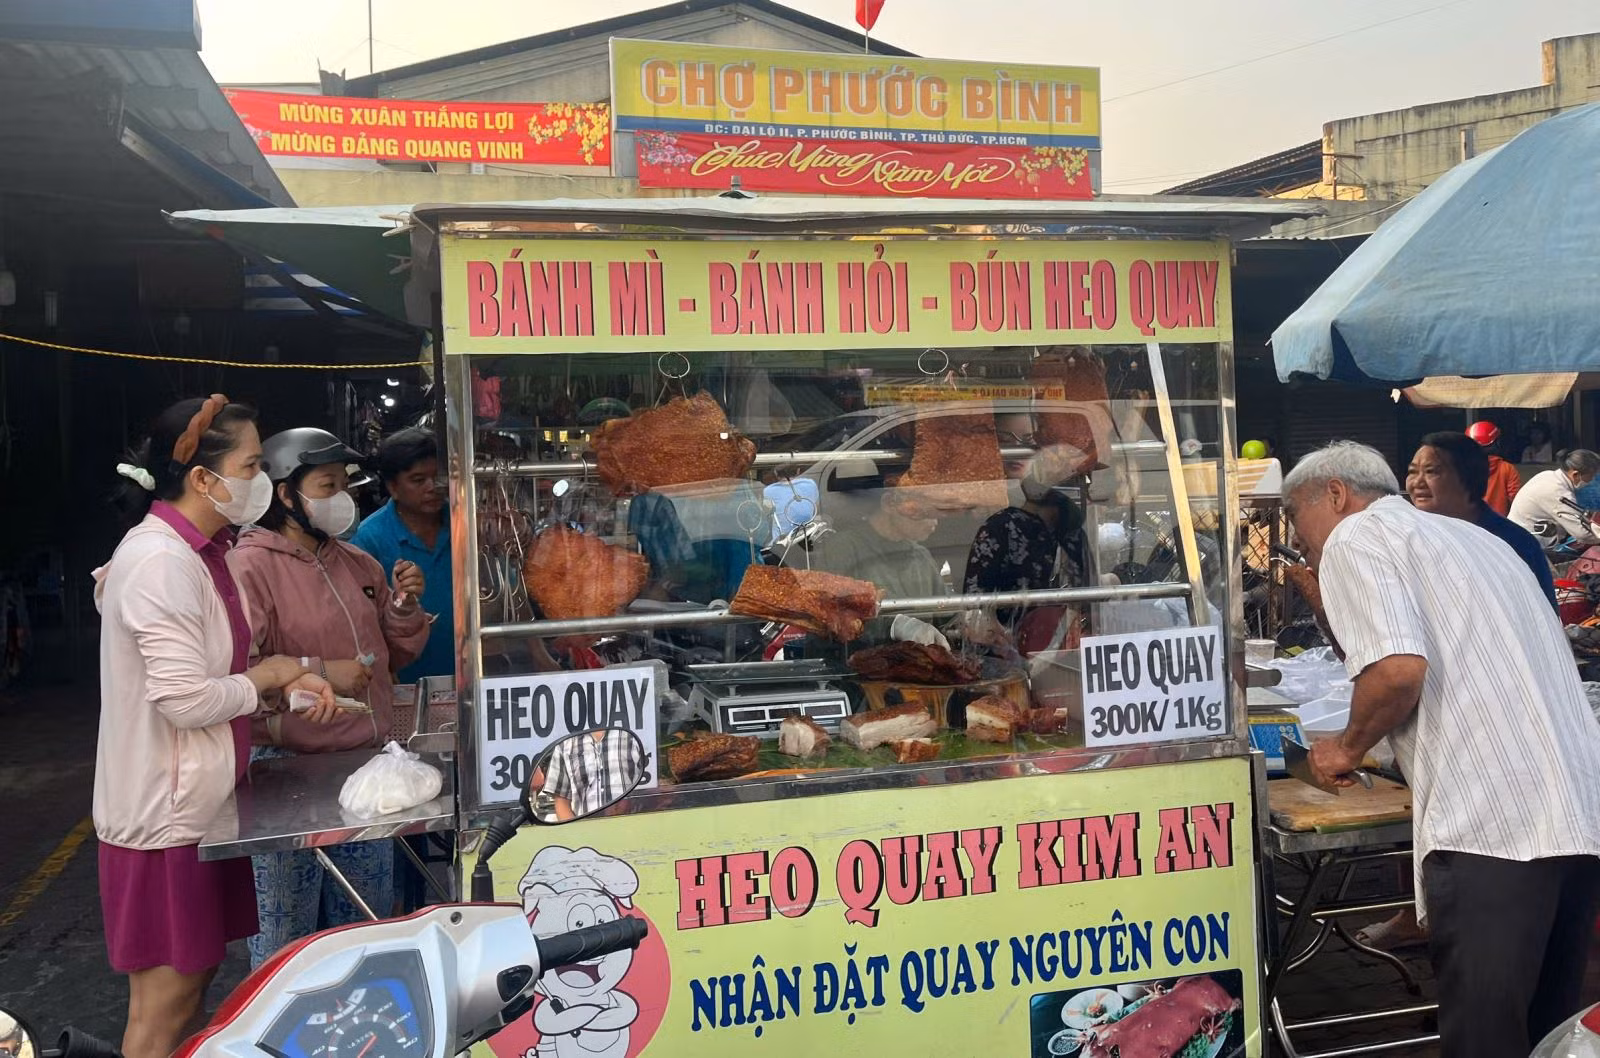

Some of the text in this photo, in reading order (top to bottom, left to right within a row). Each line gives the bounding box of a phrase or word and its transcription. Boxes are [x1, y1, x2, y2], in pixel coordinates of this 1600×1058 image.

[278, 101, 515, 135] MỪNG XUÂN THẮNG LỢI
[641, 56, 1084, 124] CHỢ PHƯỚC BÌNH
[271, 131, 525, 162] MỪNG ĐẢNG QUANG VINH
[812, 128, 857, 140] PHƯỚC
[921, 131, 945, 143] THỦ
[466, 248, 594, 337] BÁNH
[607, 249, 666, 336] MÌ
[708, 249, 825, 336] BÁNH
[836, 243, 910, 335] HỎI
[949, 249, 1032, 333] BÚN
[1043, 258, 1118, 331] HEO
[1128, 259, 1220, 337] QUAY
[1084, 634, 1216, 695] HEO QUAY
[486, 677, 650, 741] HEO QUAY
[674, 802, 1235, 931] HEO QUAY KIM AN
[688, 909, 1231, 1039] NHẬN ĐẶT QUAY NGUYÊN CON
